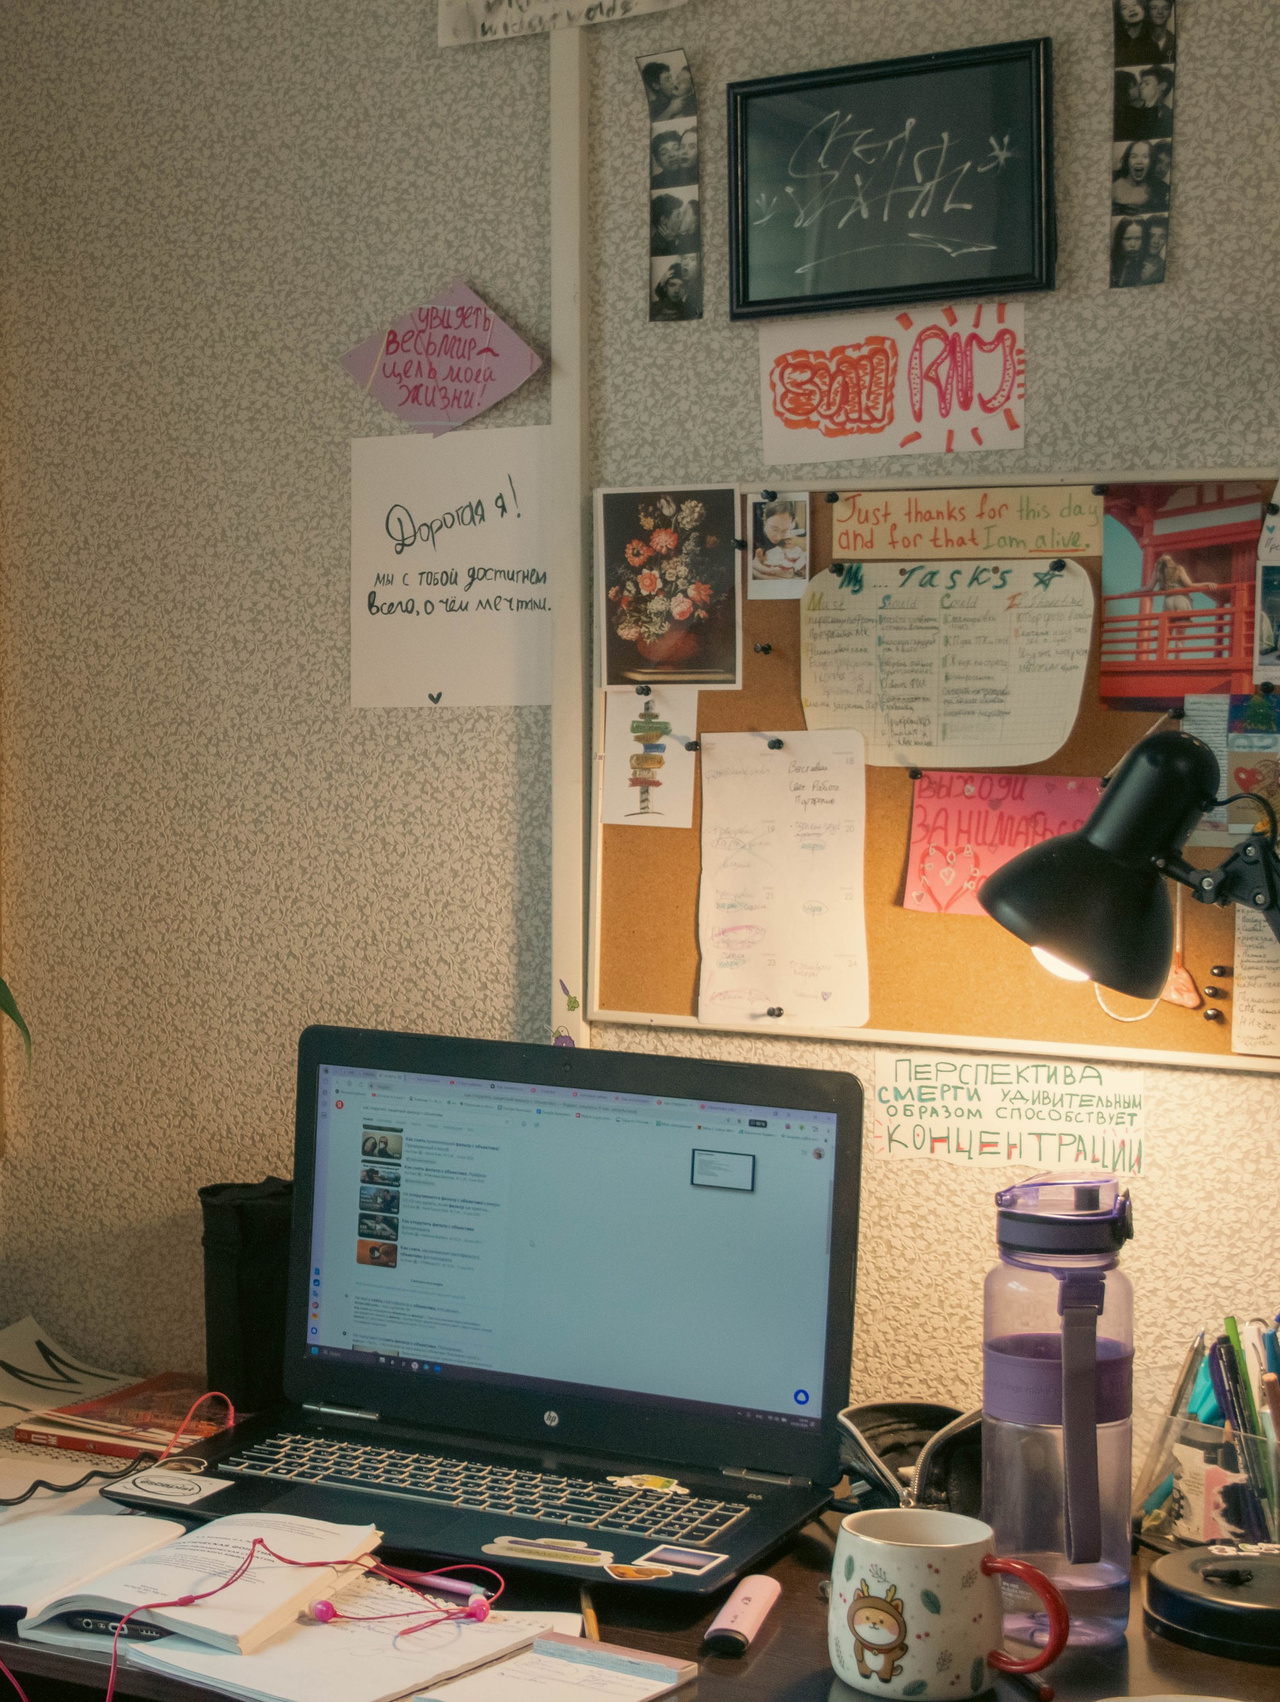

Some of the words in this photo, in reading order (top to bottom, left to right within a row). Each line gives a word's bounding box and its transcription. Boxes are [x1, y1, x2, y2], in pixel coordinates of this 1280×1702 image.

[836, 493, 891, 526] Just
[904, 497, 966, 524] thanks
[975, 493, 1009, 520] for
[1016, 496, 1051, 520] this
[1059, 493, 1100, 526] day
[385, 499, 485, 555] Дорогая
[838, 526, 874, 550] and
[888, 523, 923, 550] for
[929, 522, 980, 548] that
[418, 568, 458, 586] тобой
[464, 566, 547, 592] достигнем
[918, 774, 1028, 801] ВЫХОДИ
[895, 1058, 1103, 1086] ПЕРСПЕКТИВА
[877, 1083, 982, 1105] СМЕРТИ
[1000, 1087, 1142, 1110] УДИВИТЕЛЬНЫМ
[886, 1104, 983, 1119] ОБРАЗОМ
[995, 1106, 1138, 1126] СПОСОБСТВУЕТ
[887, 1123, 1142, 1174] КОНЦЕНТРАЦИИ
[544, 1411, 559, 1427] hp
